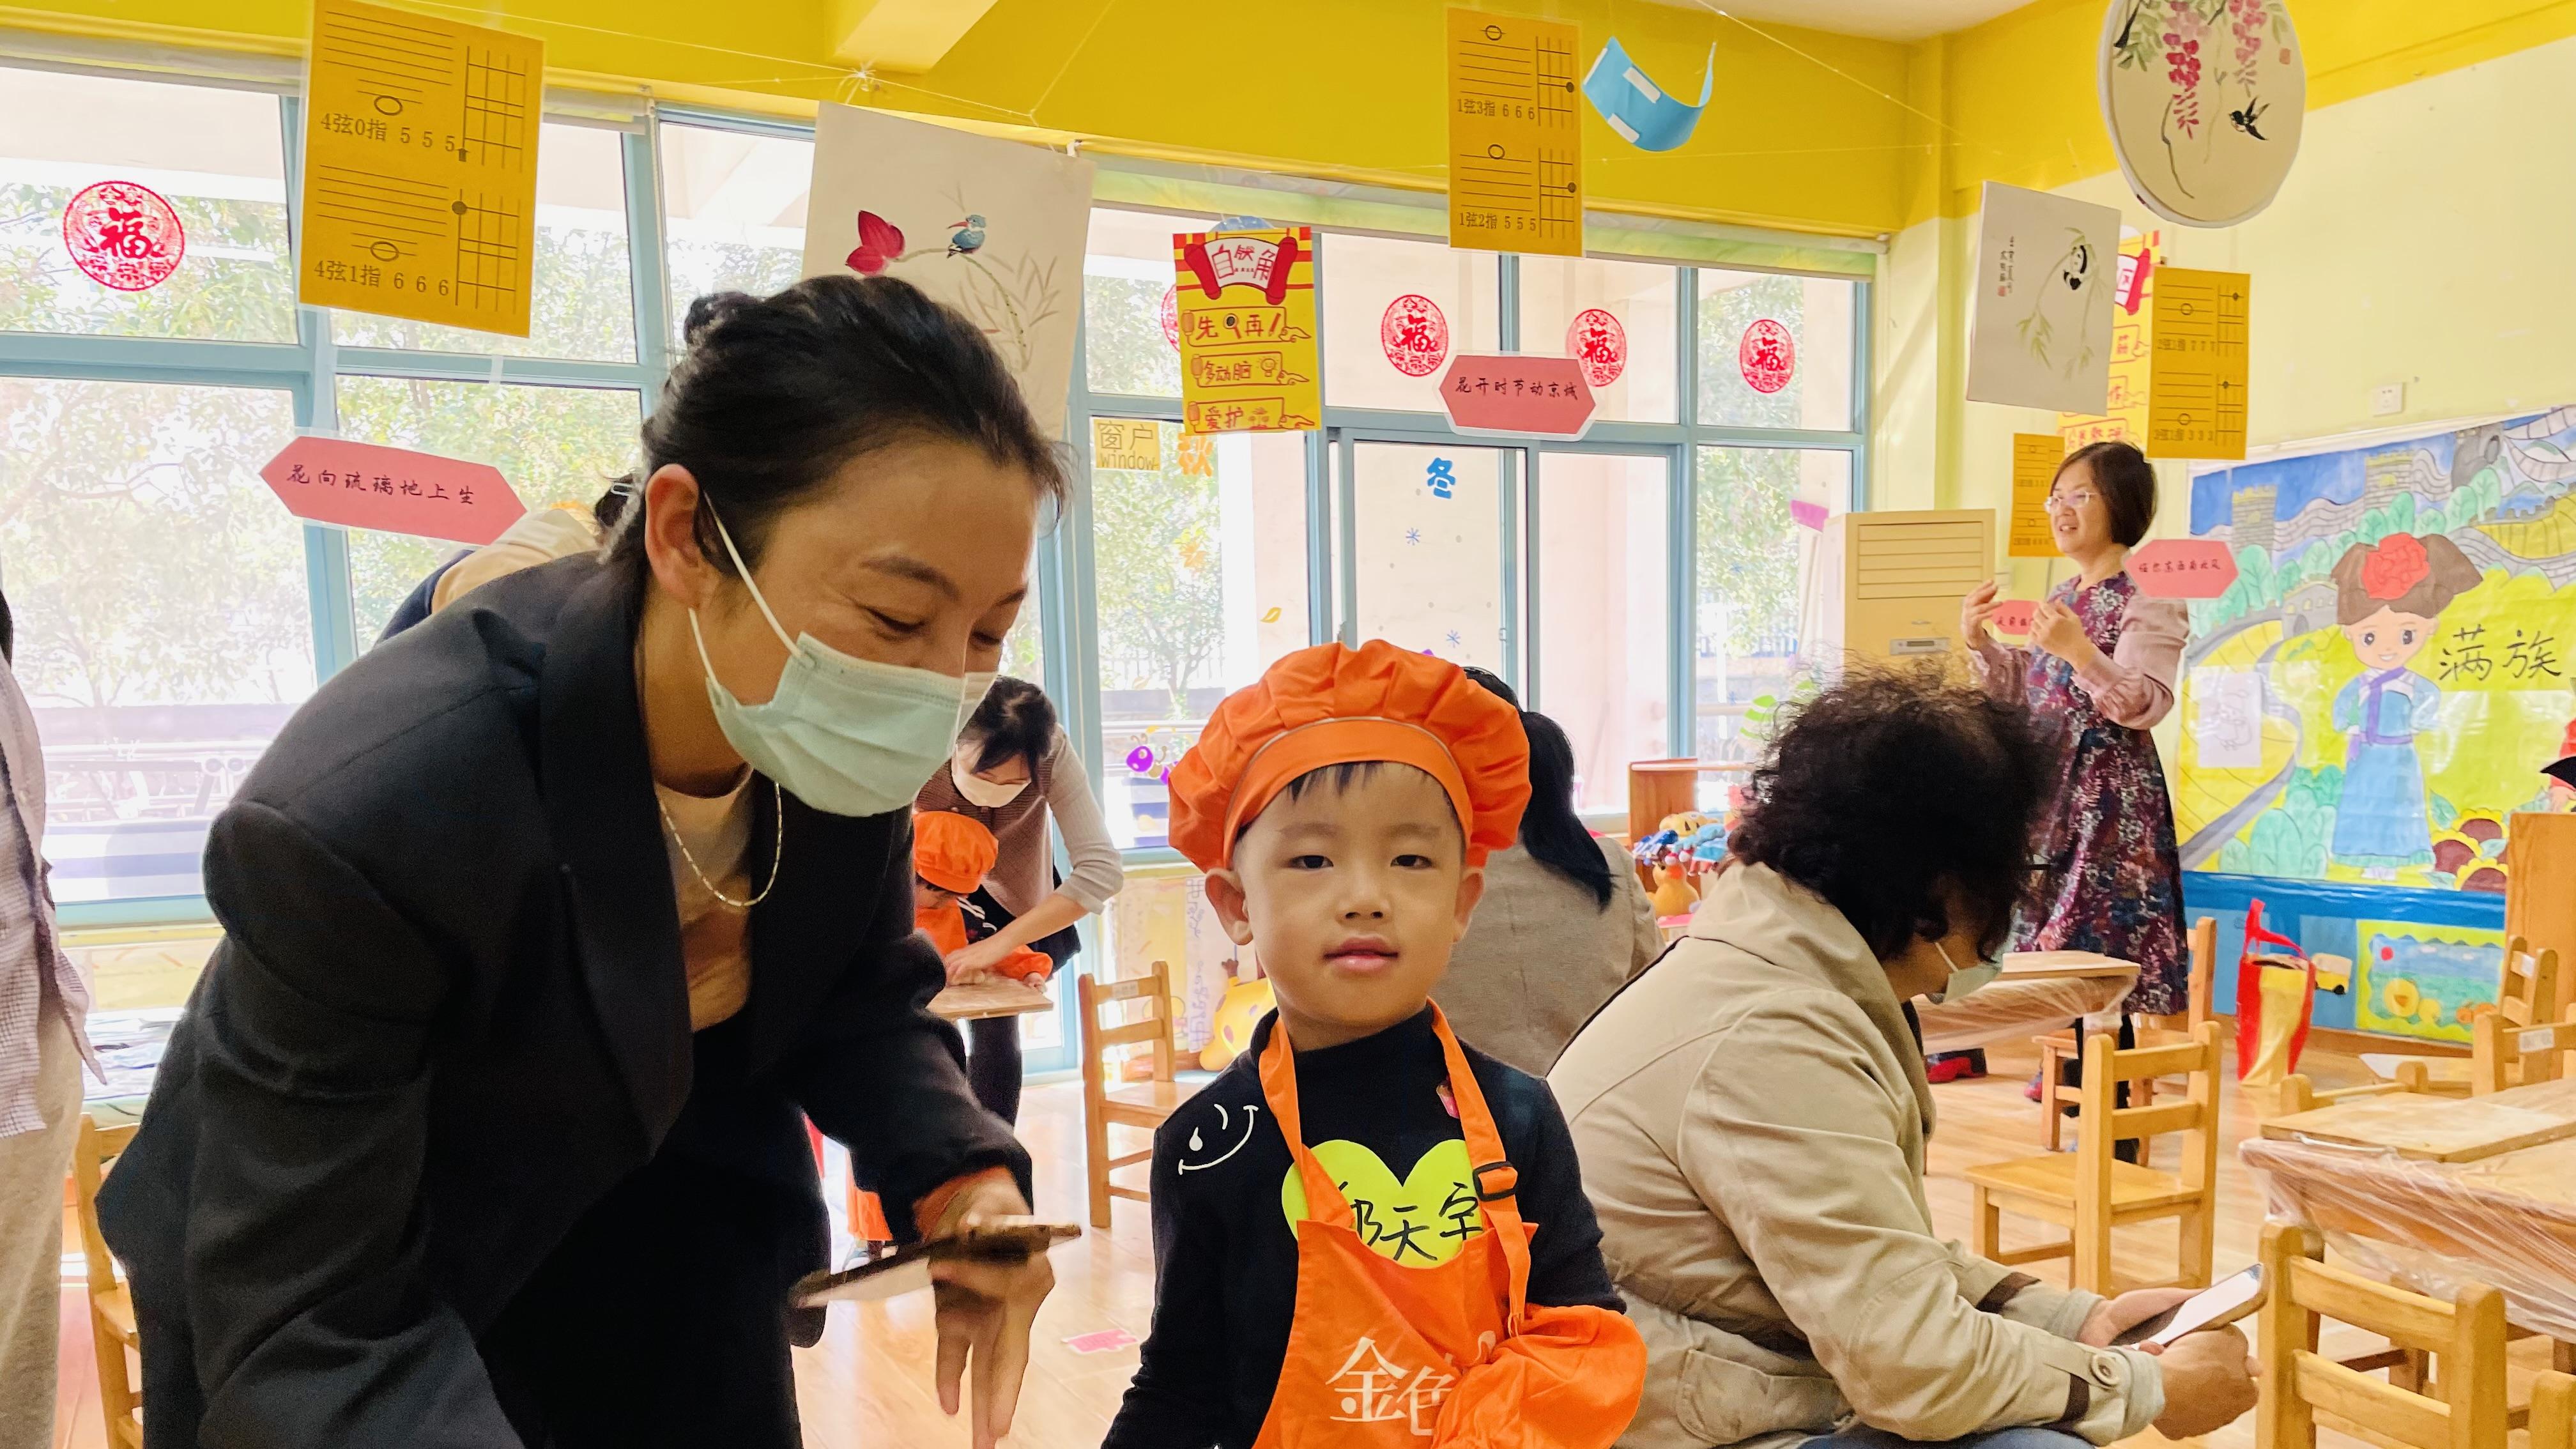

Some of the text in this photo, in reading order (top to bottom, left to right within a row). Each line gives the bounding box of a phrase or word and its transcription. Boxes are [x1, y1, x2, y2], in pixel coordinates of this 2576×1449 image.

[1457, 98, 1535, 120] 1弦3指 6 6 6
[321, 112, 455, 151] 4弦0指 5 5 5
[100, 208, 152, 259] 福
[1459, 211, 1537, 231] 1弦2指 5 5 5
[314, 260, 449, 296] 4弦1指 6 6 6
[1211, 243, 1277, 281] 自然角
[1196, 314, 1264, 340] 先 再
[1400, 314, 1431, 352] 福
[1584, 328, 1612, 363] 福
[1756, 337, 1781, 371] 福
[1204, 360, 1252, 383] 多动脑
[1455, 376, 1578, 400] 花开时节动京城
[1098, 420, 1154, 450] 窗户
[1205, 405, 1243, 430] 爱护
[1100, 450, 1158, 471] window
[1177, 431, 1213, 477] 秋
[287, 464, 473, 505] 花向琉璃地上生
[1427, 457, 1456, 499] 冬
[2439, 624, 2562, 682] 满族
[1325, 1335, 1463, 1436] 金色
